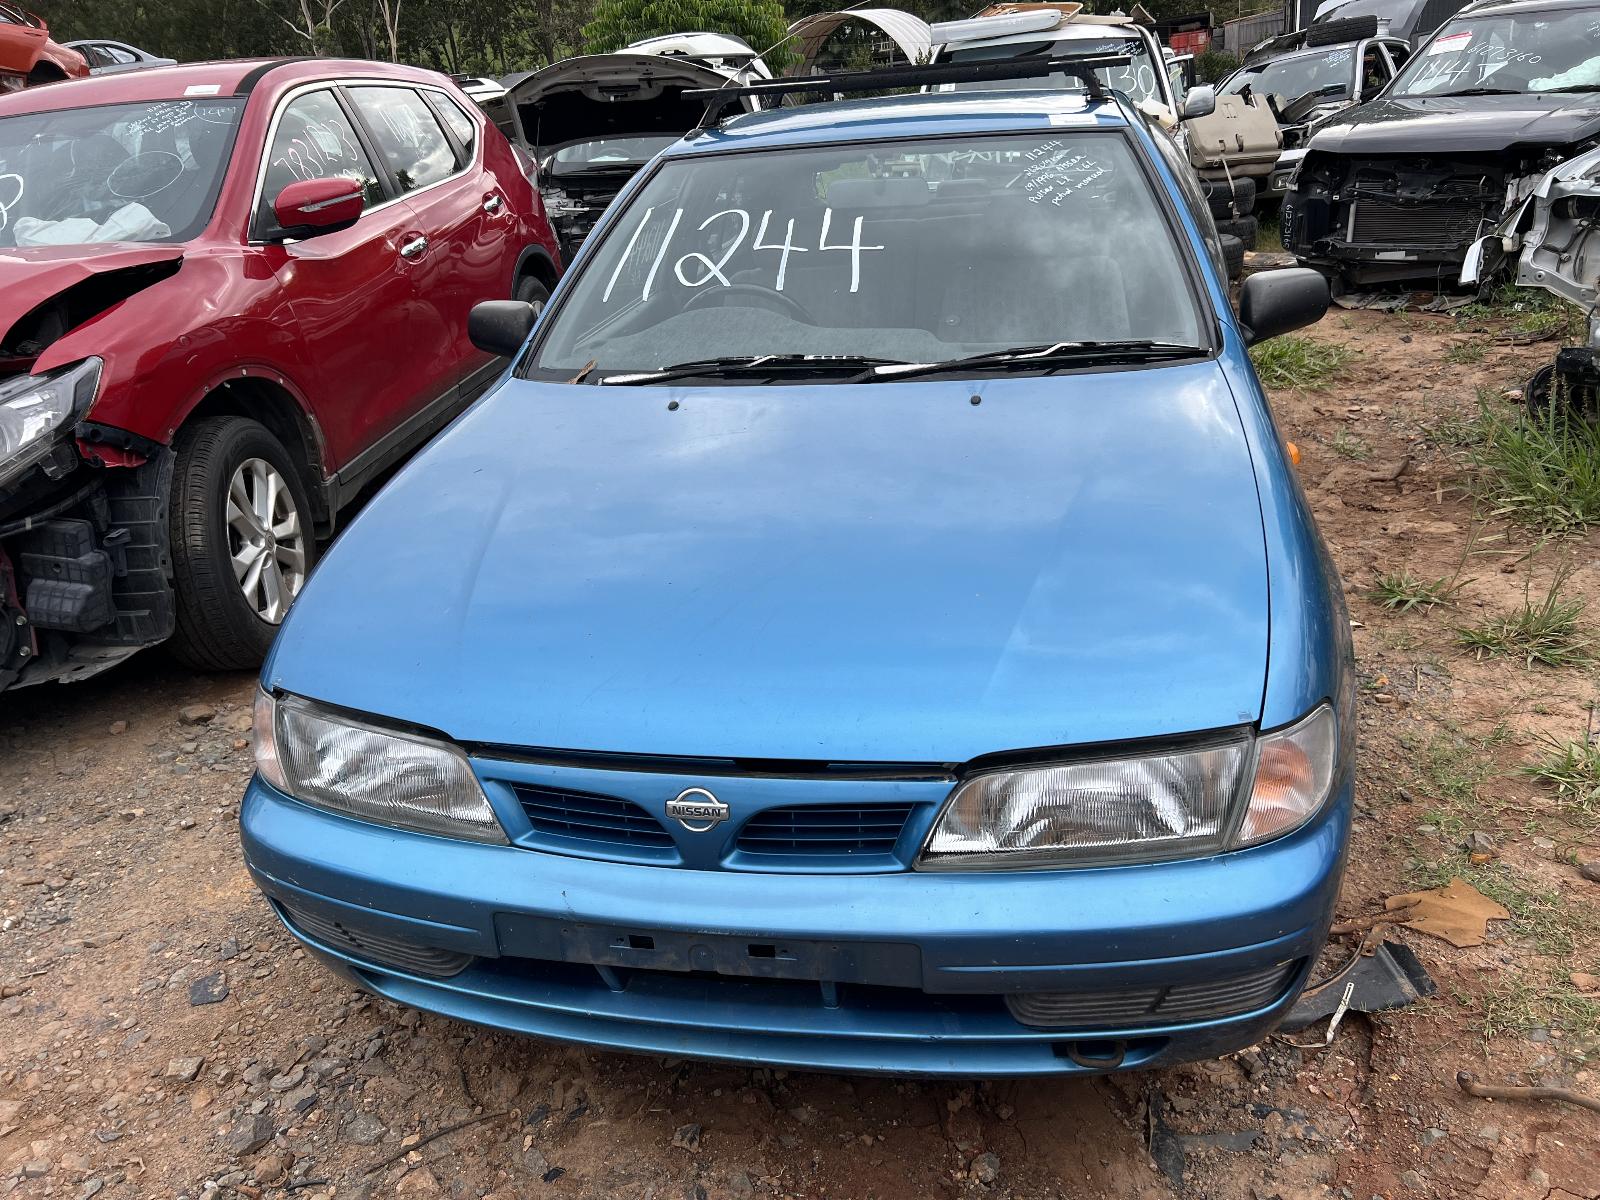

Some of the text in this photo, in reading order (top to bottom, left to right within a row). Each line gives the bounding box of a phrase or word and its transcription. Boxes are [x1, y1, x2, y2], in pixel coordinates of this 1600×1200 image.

[1024, 140, 1064, 160] 11244
[602, 207, 885, 303] 11244
[672, 805, 721, 817] NISSAN
